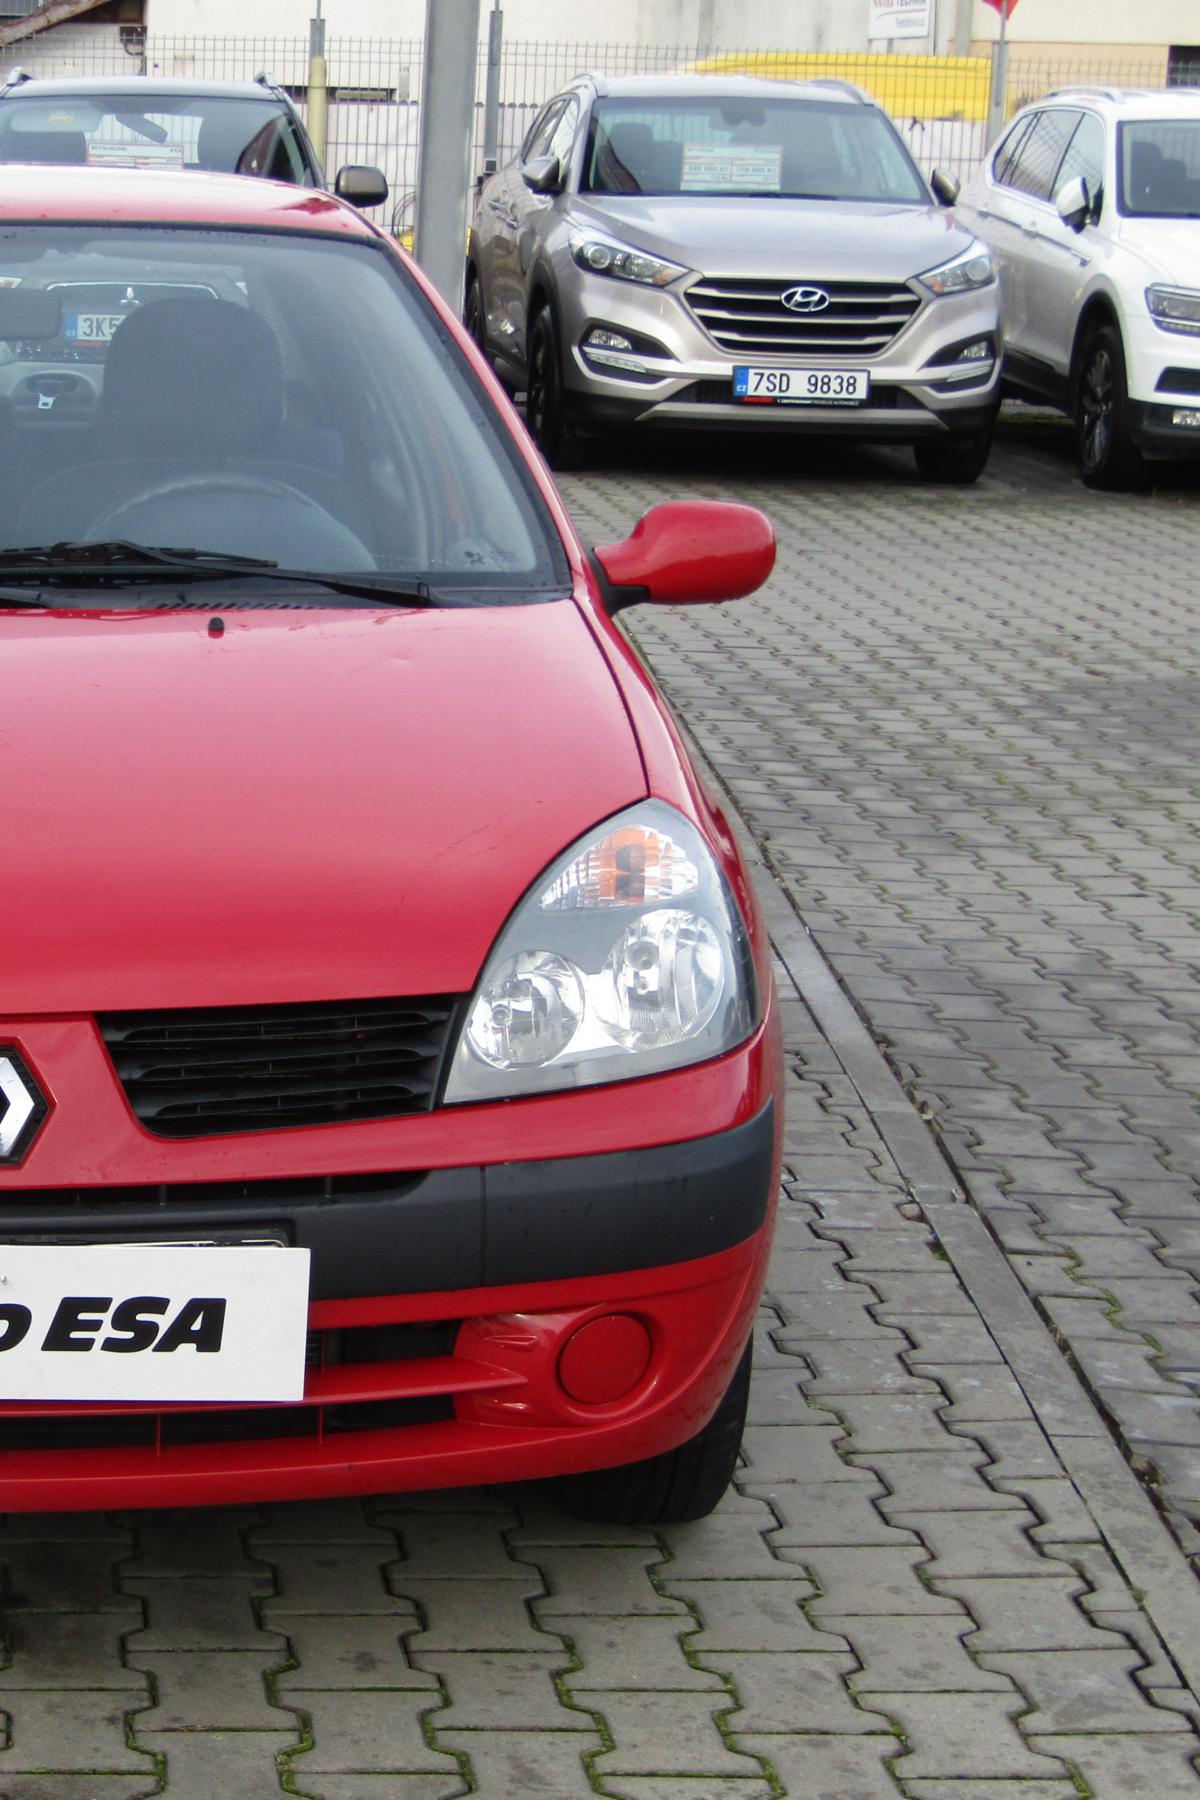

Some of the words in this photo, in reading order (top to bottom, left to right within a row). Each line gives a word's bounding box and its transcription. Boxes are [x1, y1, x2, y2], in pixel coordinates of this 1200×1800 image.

[736, 384, 747, 392] CZ
[753, 372, 791, 393] 7SD
[807, 374, 858, 395] 9838
[40, 1296, 227, 1354] ESA
